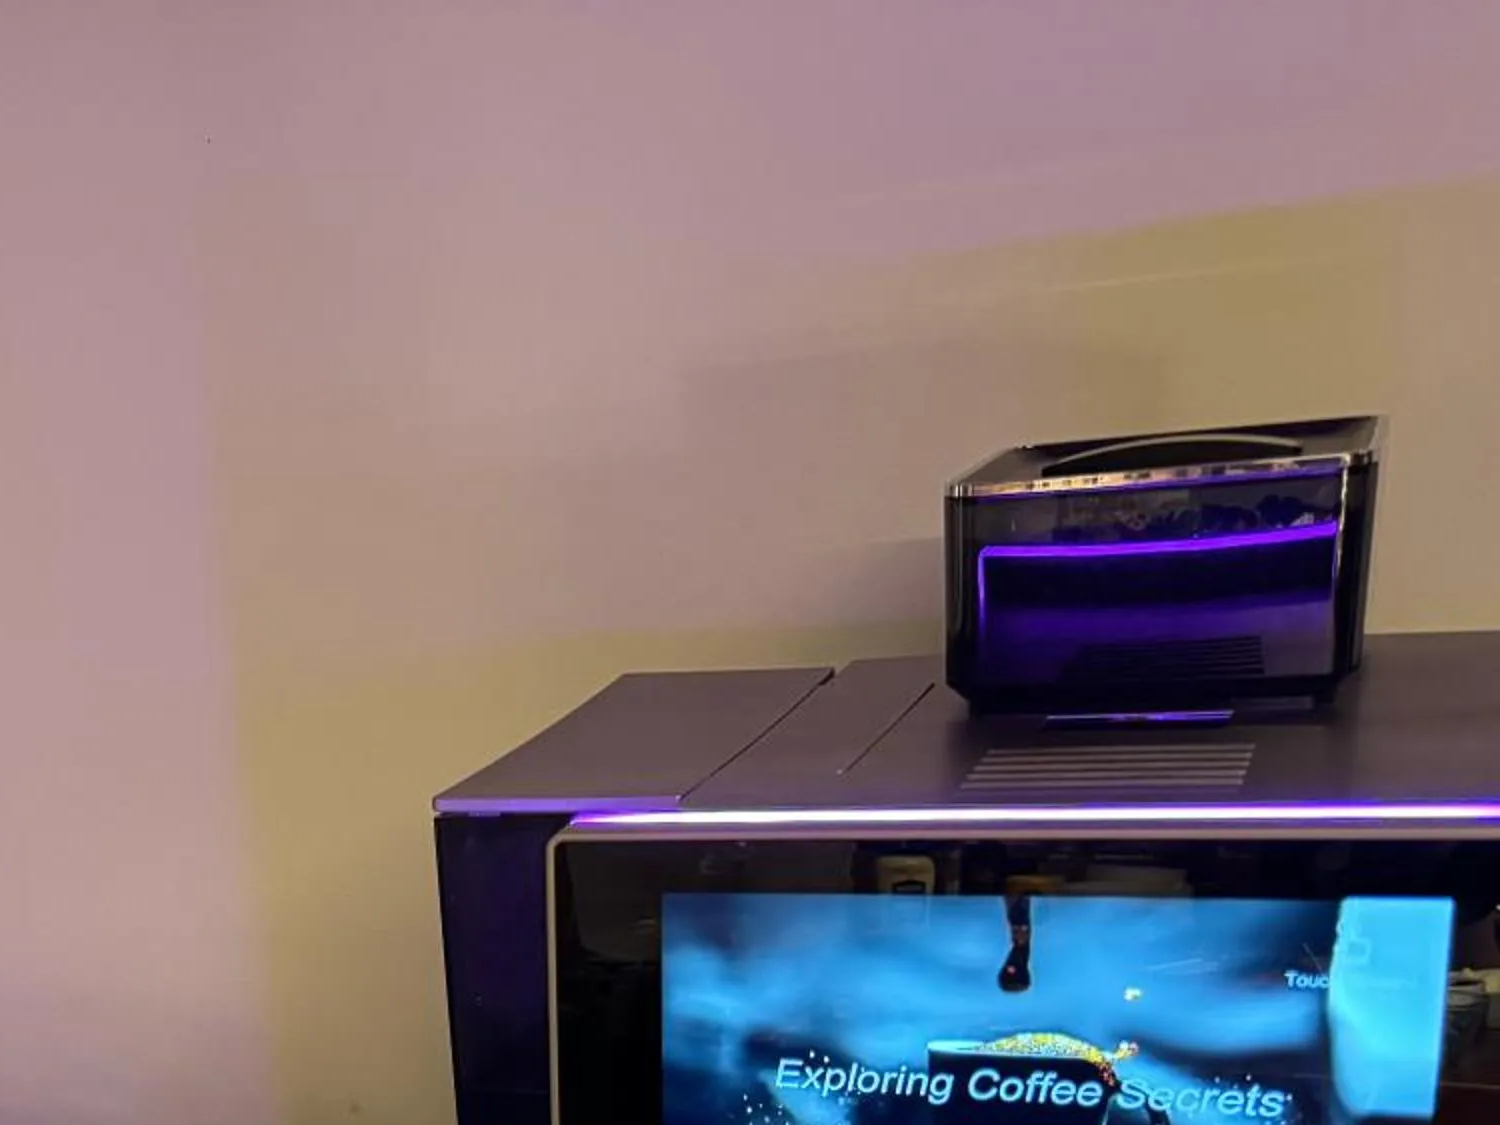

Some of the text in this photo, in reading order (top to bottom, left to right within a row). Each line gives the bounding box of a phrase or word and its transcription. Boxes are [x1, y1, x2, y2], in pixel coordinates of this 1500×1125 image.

[776, 1057, 1287, 1118] Exploring Coffee Secrets
